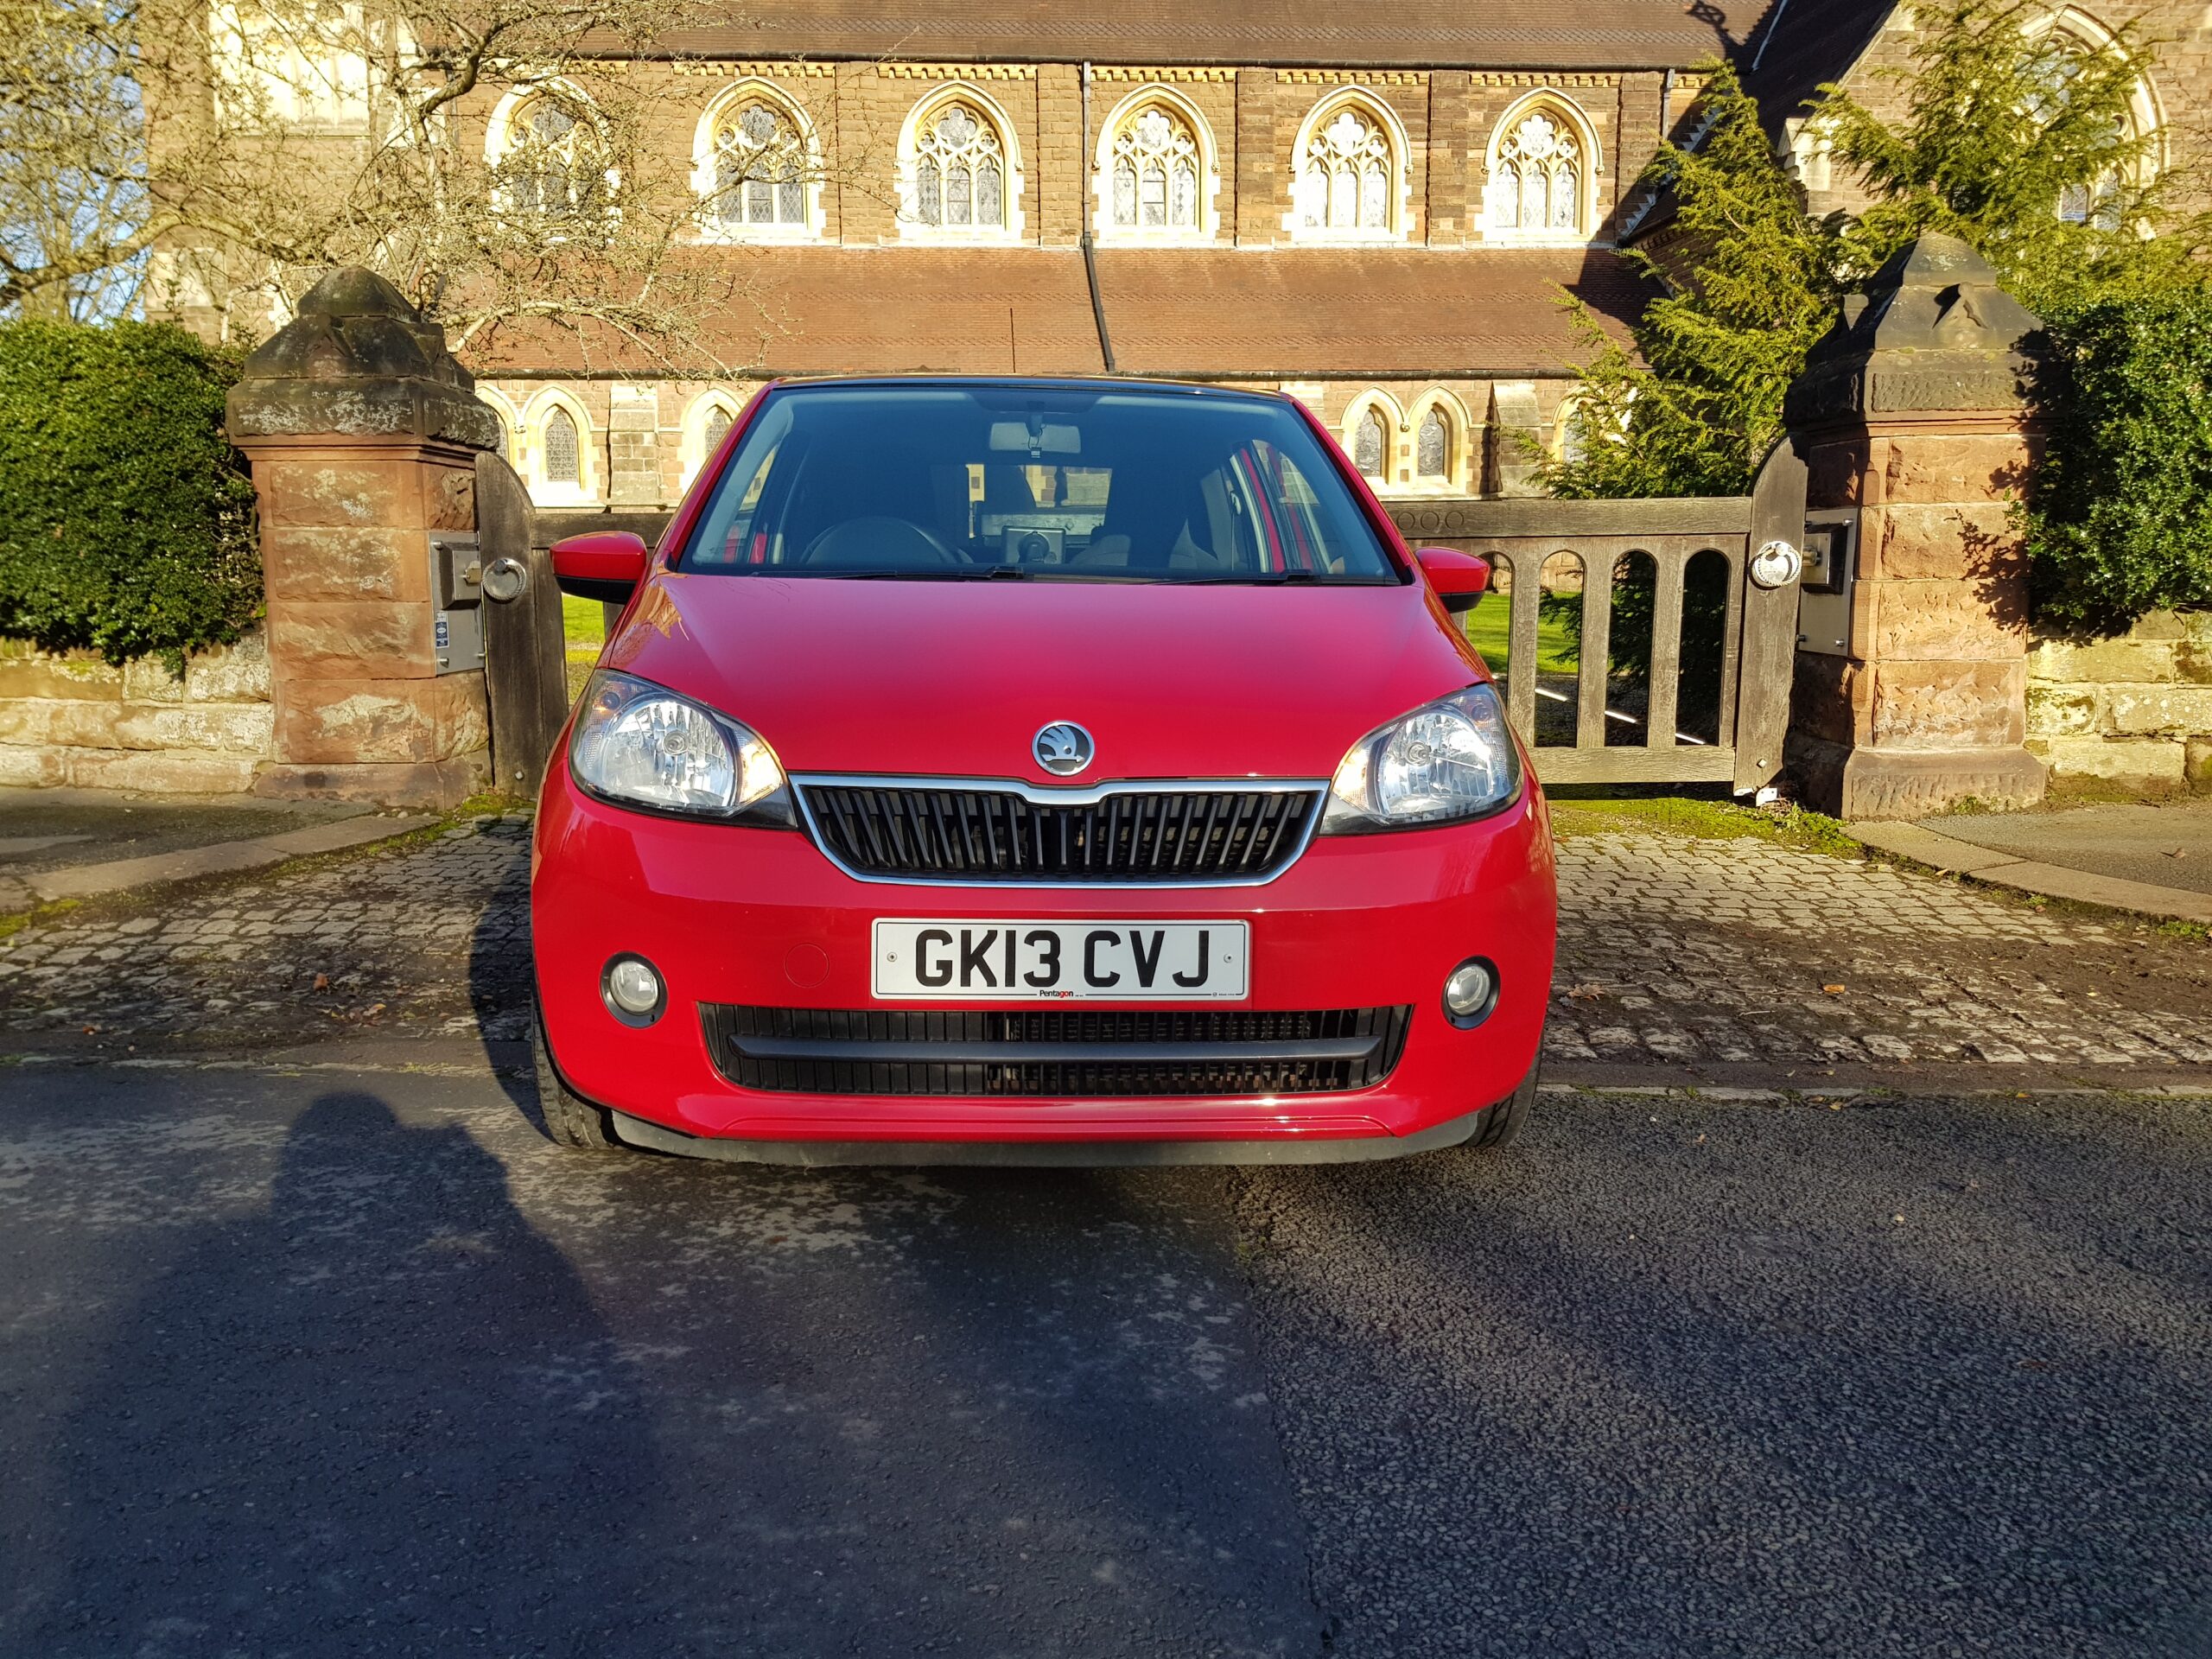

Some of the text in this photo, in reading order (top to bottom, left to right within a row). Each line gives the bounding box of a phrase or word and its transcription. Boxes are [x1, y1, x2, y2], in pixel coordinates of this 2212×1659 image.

[916, 929, 1209, 988] GK13 CVJ
[1039, 989, 1074, 998] Pentagon
